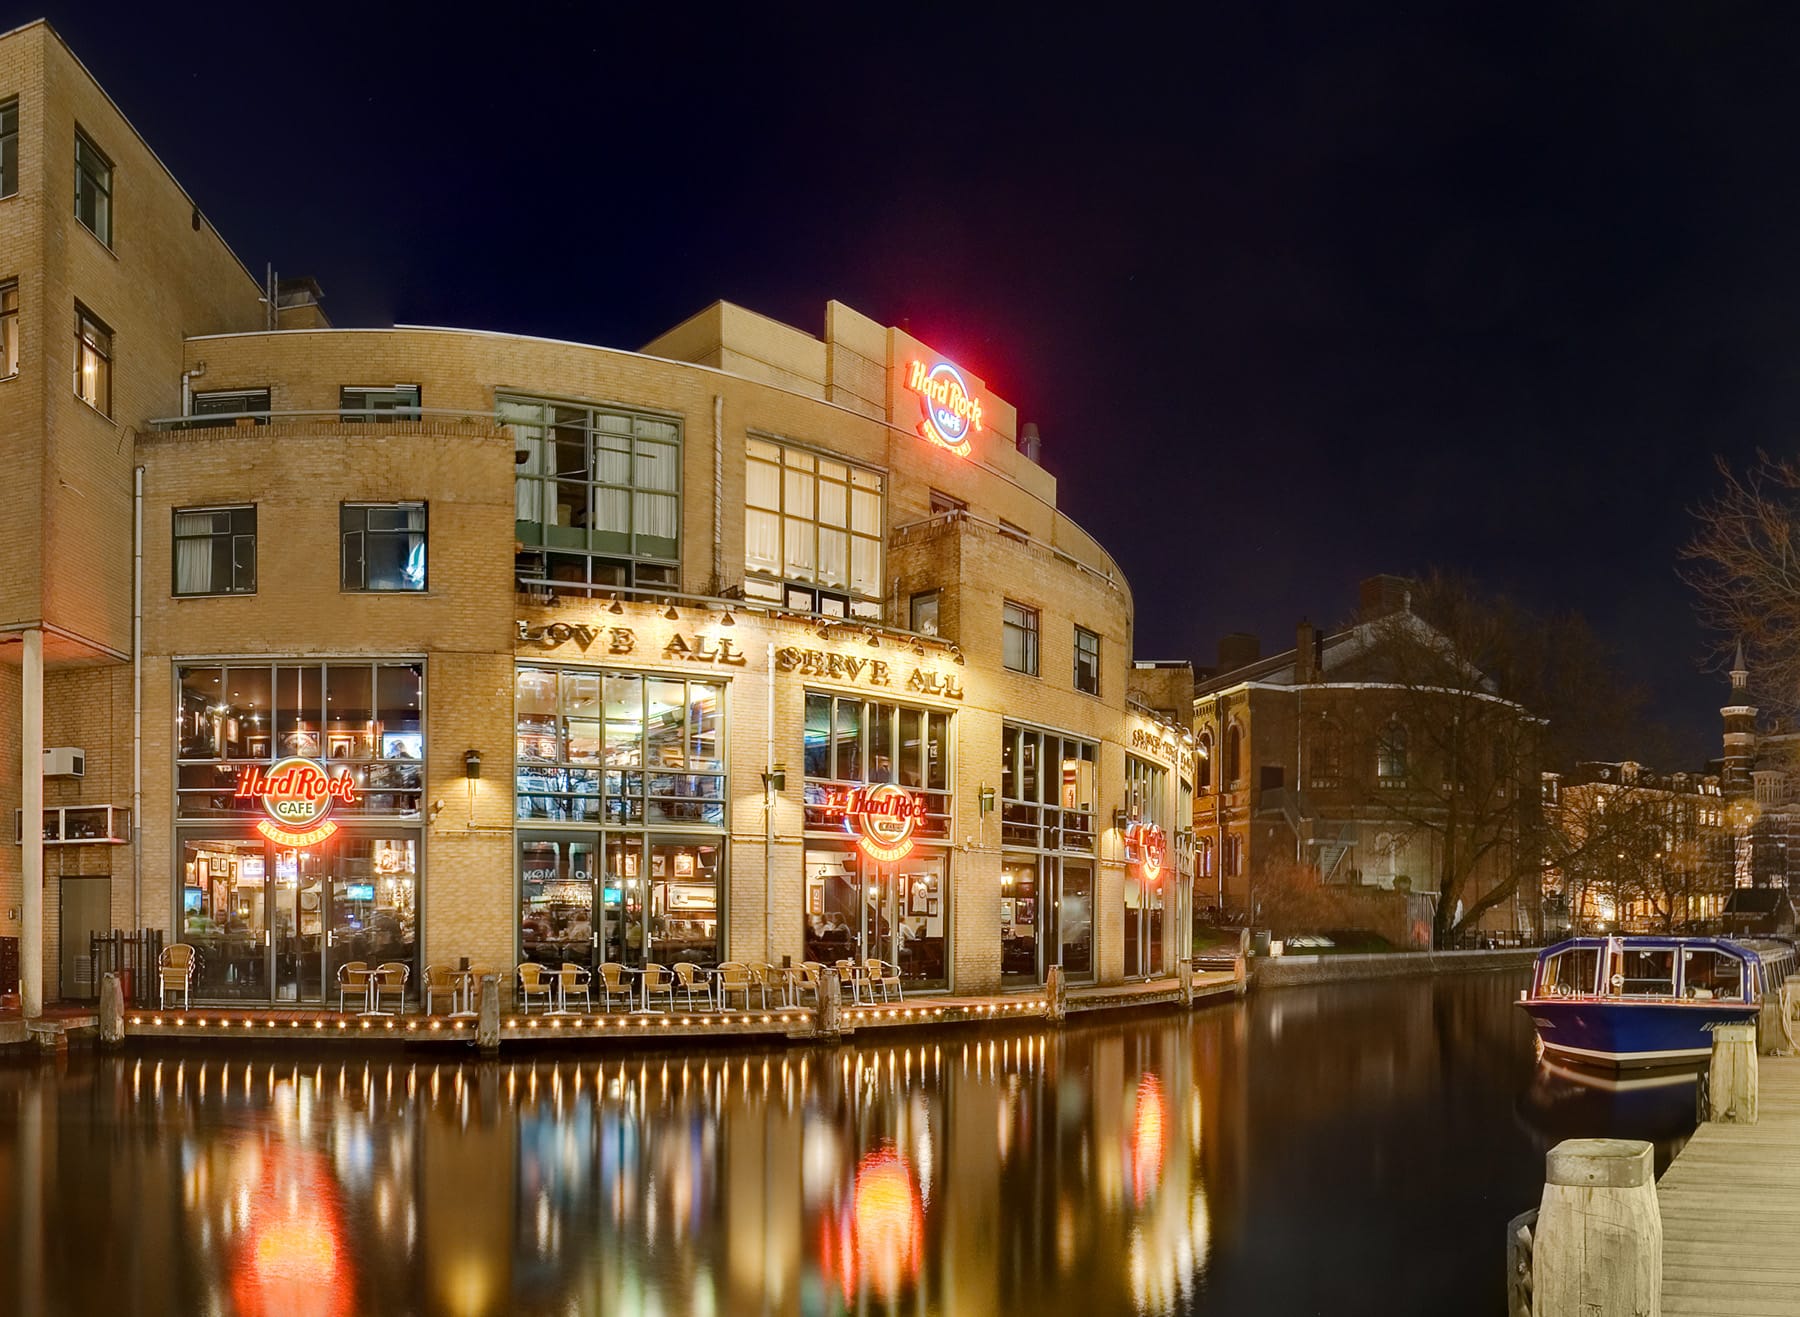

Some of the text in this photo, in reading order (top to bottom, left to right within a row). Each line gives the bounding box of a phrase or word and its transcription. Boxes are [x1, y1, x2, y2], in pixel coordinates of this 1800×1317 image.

[910, 360, 982, 431] Hard Rock
[936, 409, 961, 431] CAFE
[515, 619, 745, 663] LOVE ALL
[776, 647, 964, 695] SERVE ALL
[234, 766, 356, 803] Hard Rock
[278, 801, 313, 815] CAFE
[846, 789, 928, 826] Hard Rock
[258, 820, 337, 846] AMSTERDAM
